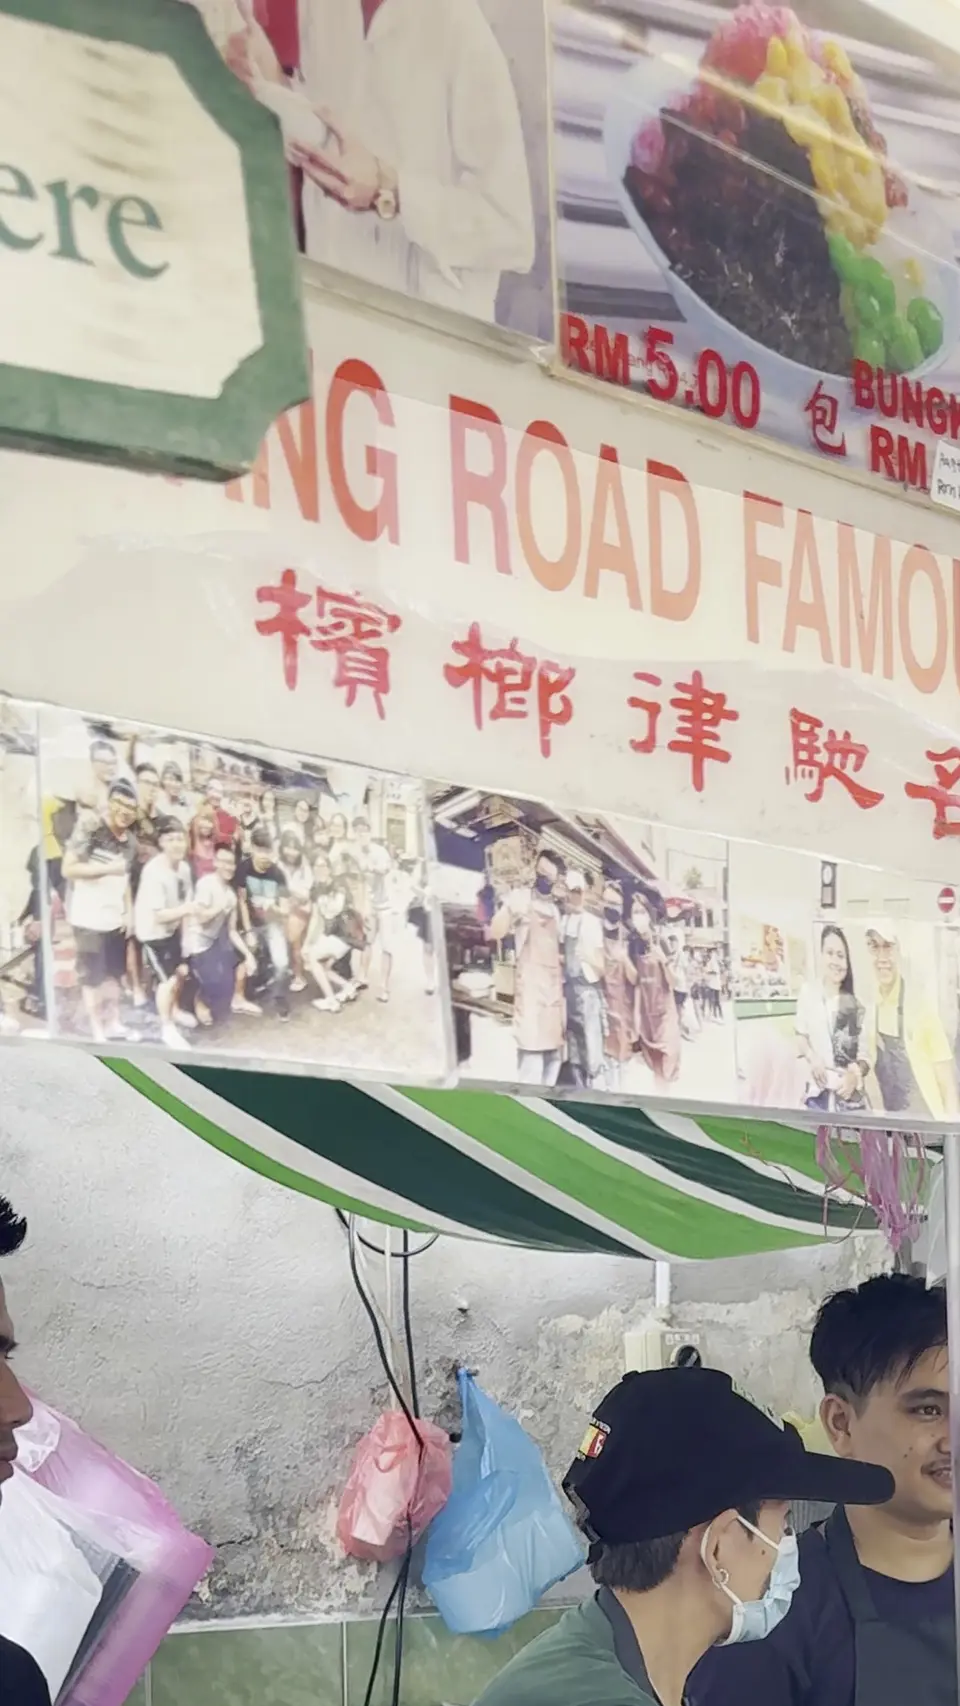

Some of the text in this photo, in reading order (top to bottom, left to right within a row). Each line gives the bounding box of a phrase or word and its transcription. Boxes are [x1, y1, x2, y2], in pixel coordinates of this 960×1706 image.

[225, 345, 402, 546] NG
[448, 394, 702, 622] ROAD
[870, 424, 928, 490] RM
